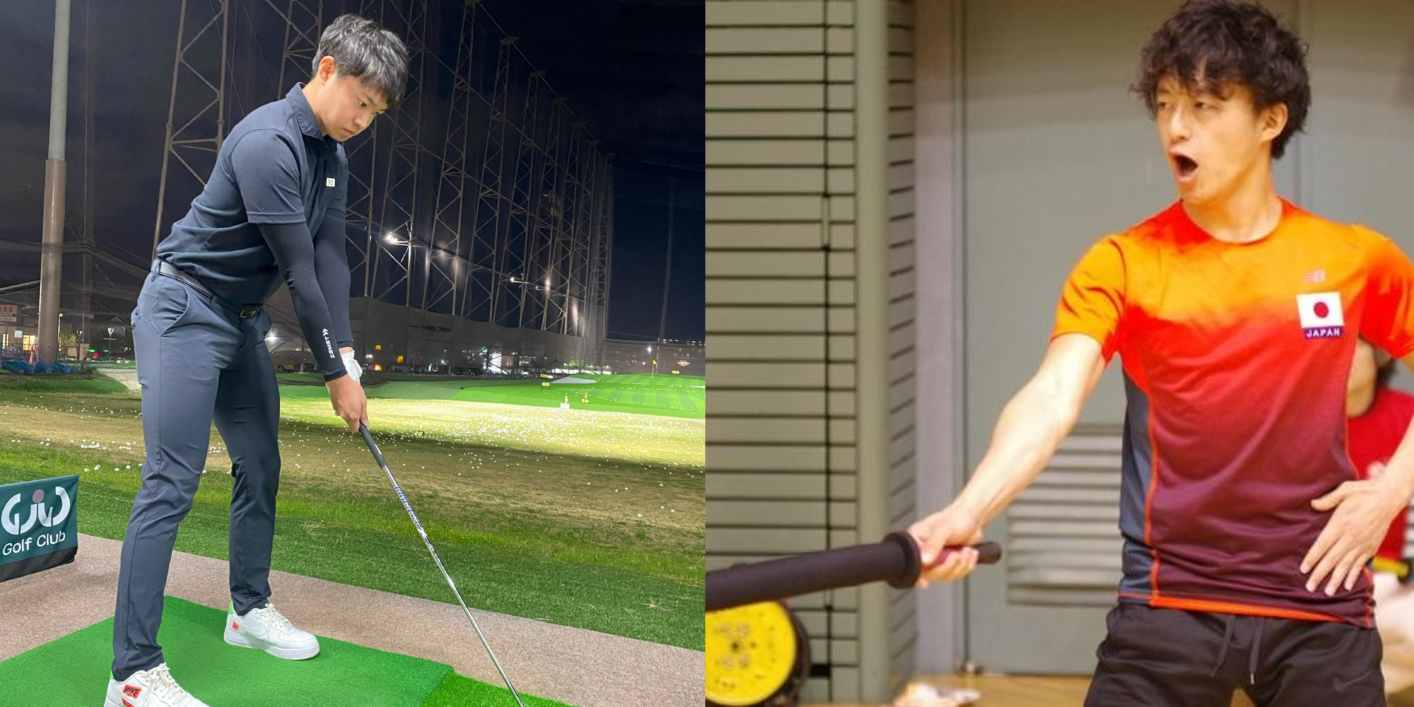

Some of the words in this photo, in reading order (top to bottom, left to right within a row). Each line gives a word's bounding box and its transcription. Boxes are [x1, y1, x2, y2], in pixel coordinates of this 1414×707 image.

[1305, 327, 1341, 338] JAPAN
[2, 537, 32, 556] Golf
[36, 531, 66, 547] Club
